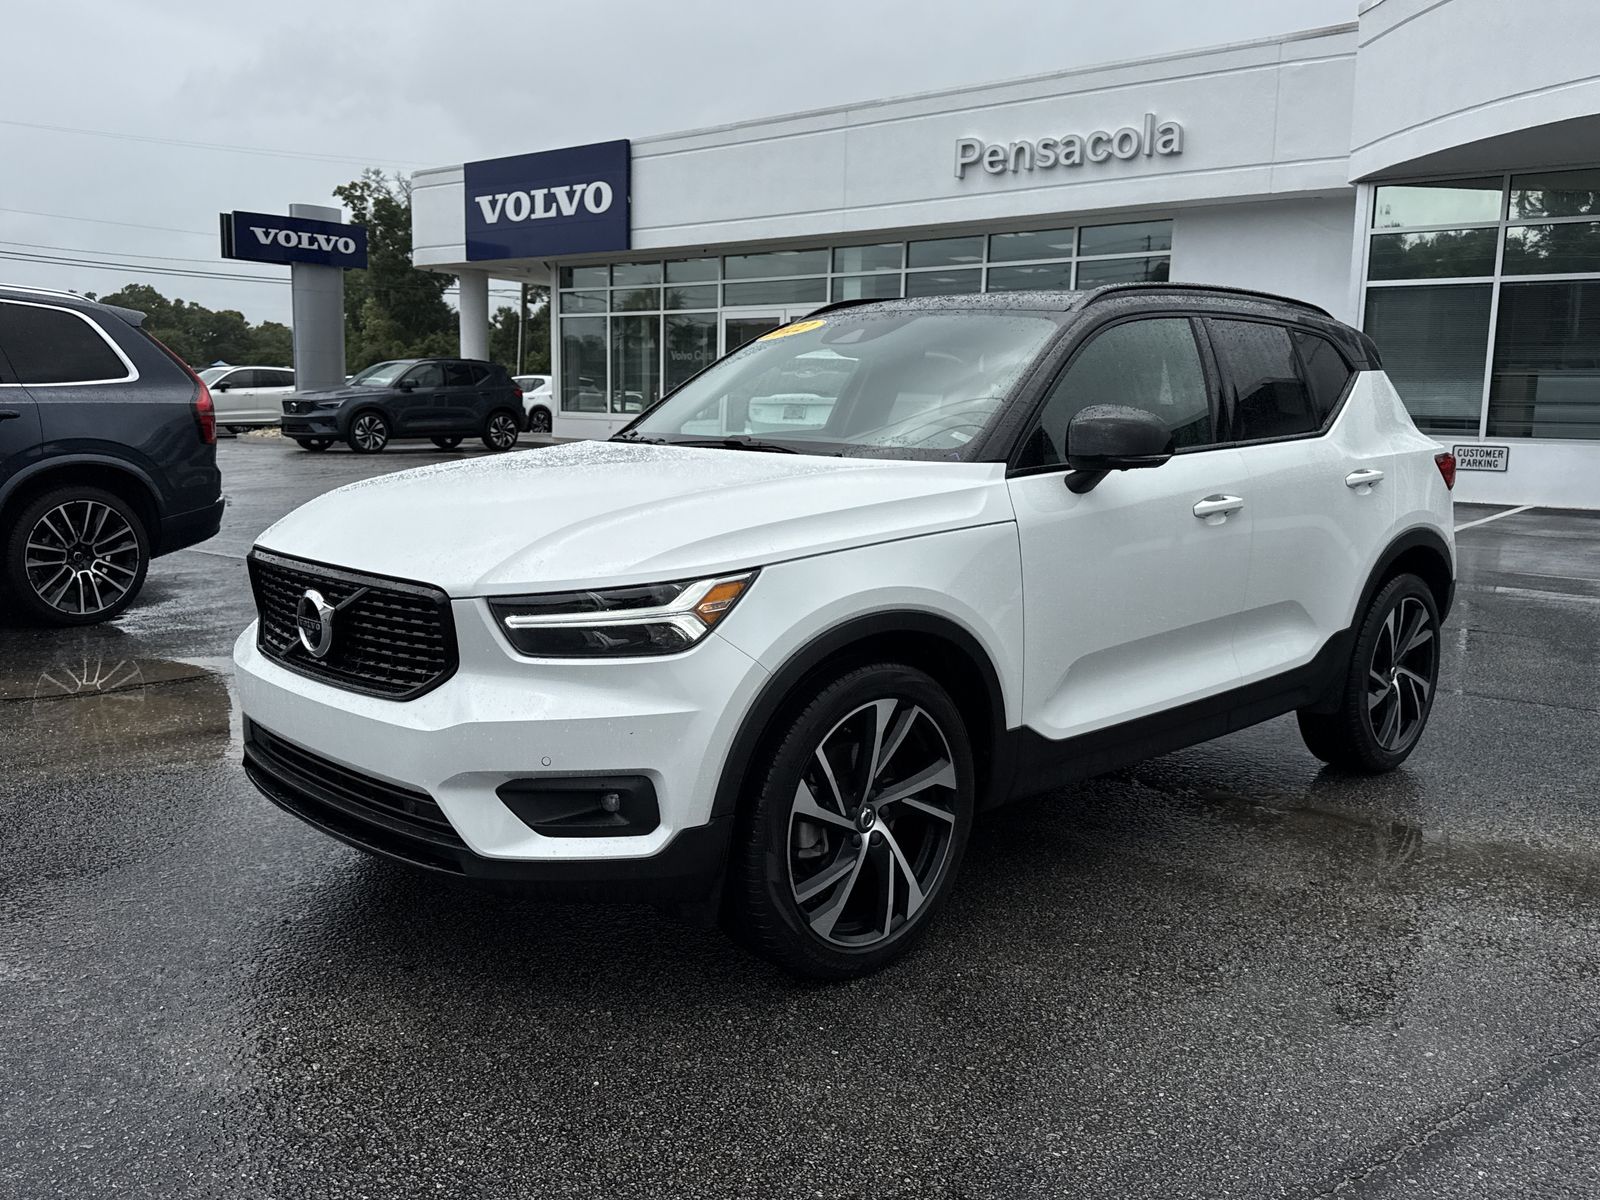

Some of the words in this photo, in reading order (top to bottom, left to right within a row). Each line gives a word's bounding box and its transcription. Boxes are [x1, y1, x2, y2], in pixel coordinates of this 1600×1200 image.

[954, 113, 1184, 179] Pensacola
[475, 181, 613, 224] VOLVO
[249, 226, 356, 254] VOLVO
[670, 350, 693, 361] Volvo
[1457, 449, 1504, 459] CUSTOMER
[1460, 458, 1498, 468] PARKING
